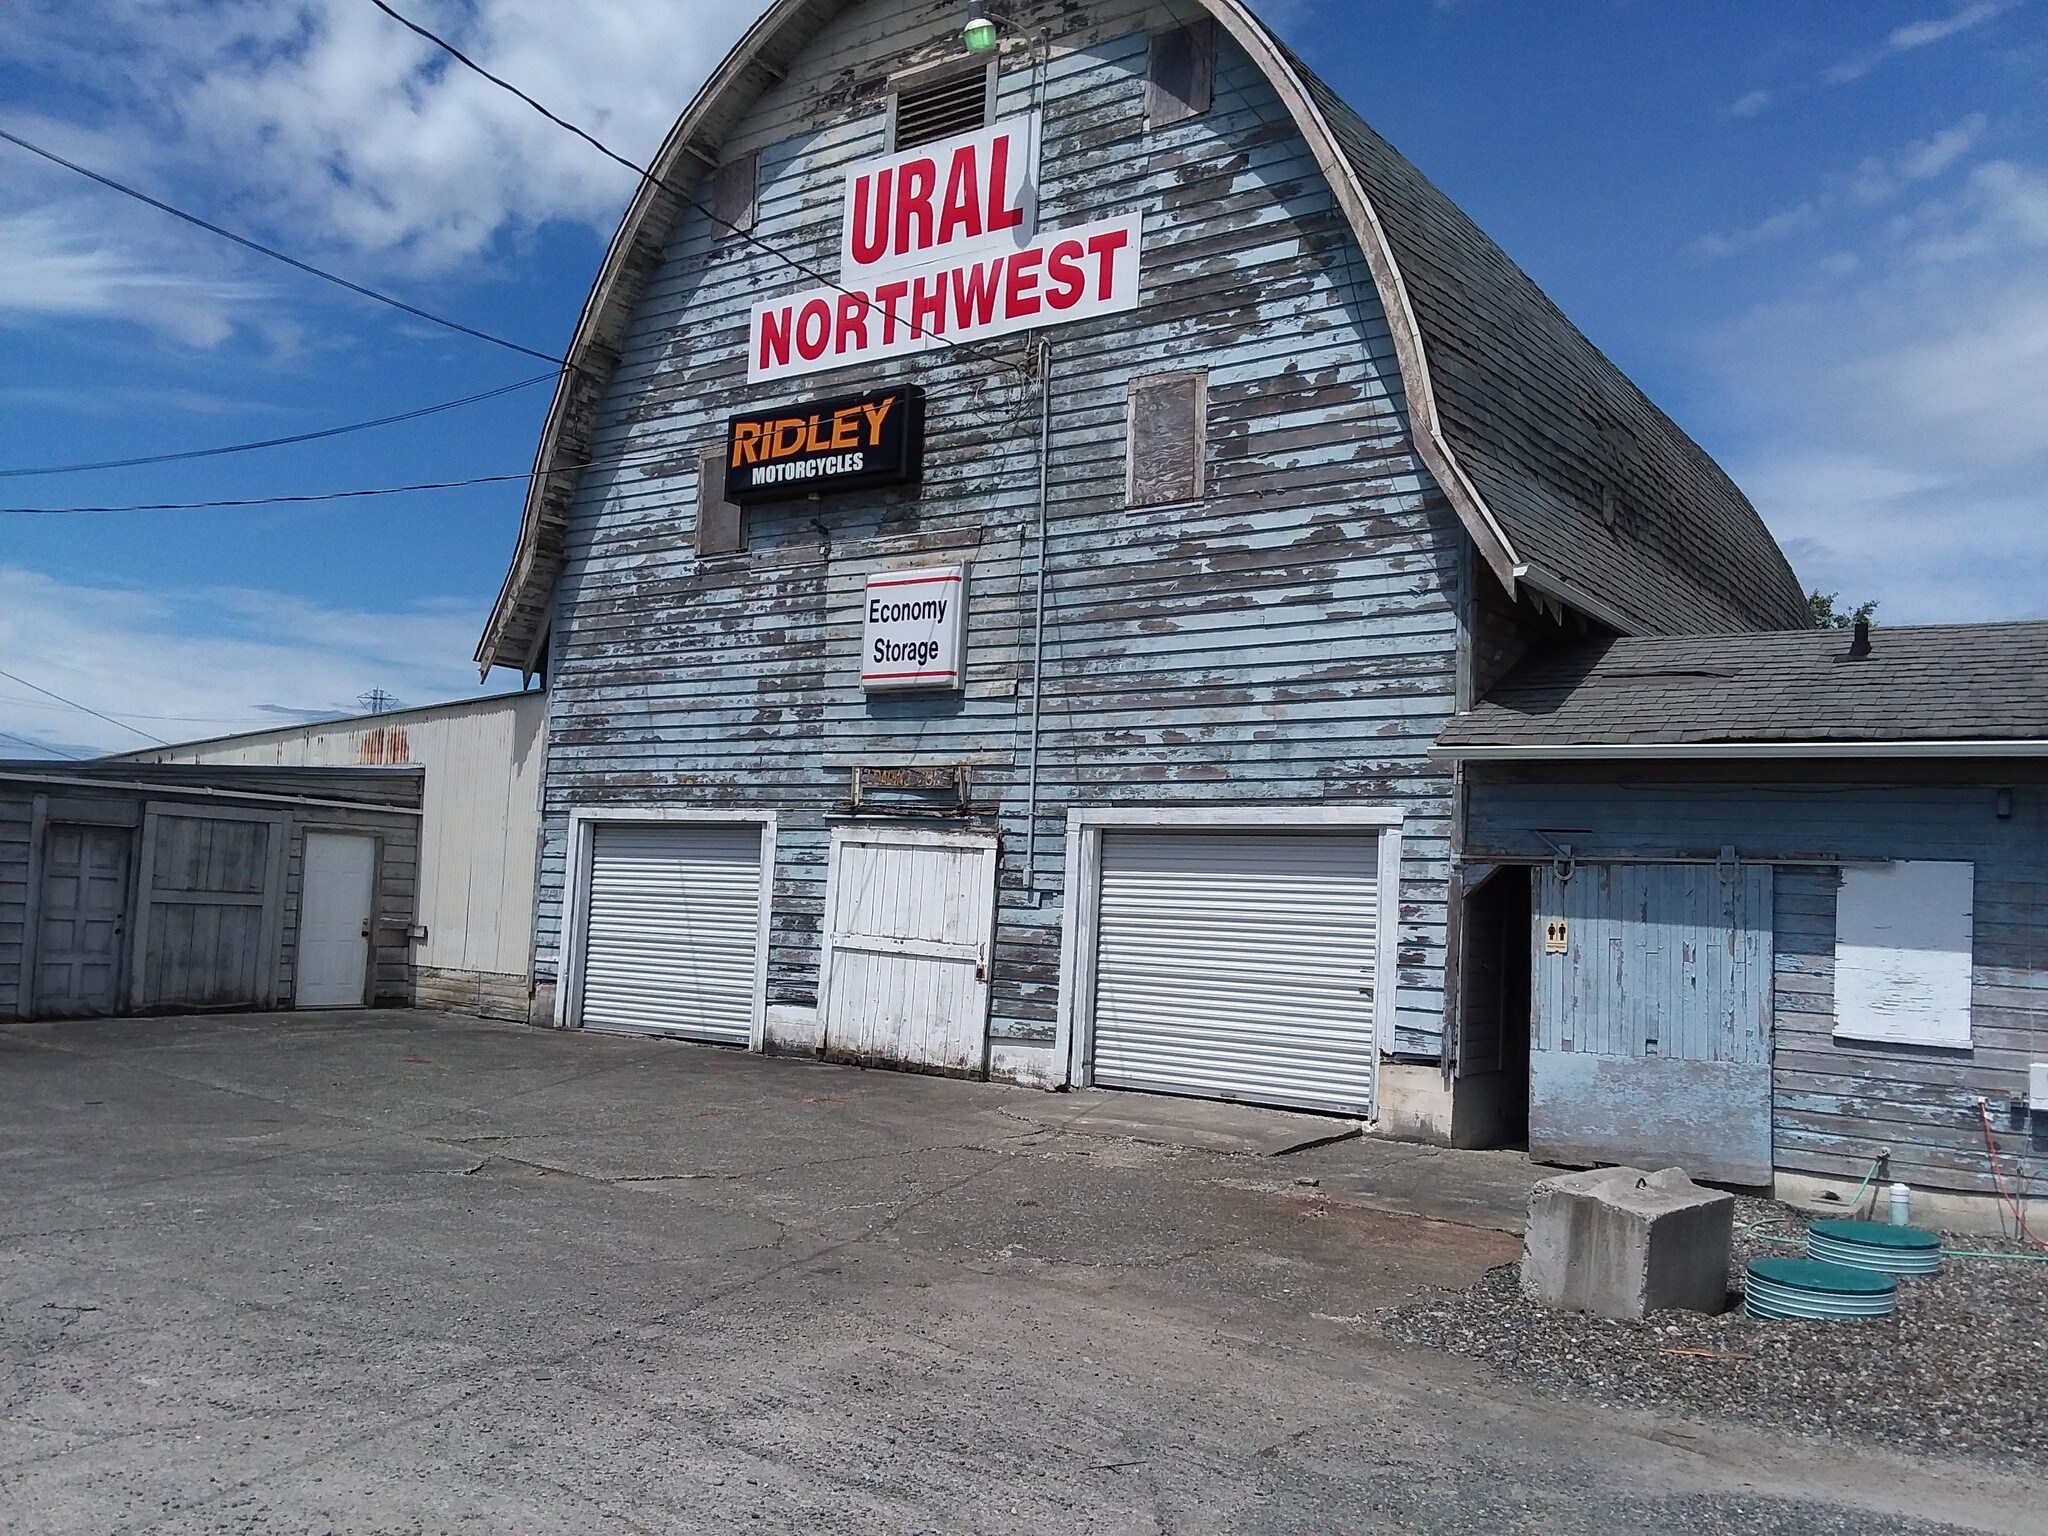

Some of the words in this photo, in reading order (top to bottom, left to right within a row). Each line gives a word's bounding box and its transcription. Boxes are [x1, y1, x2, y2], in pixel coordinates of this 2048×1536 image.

[850, 135, 1024, 265] URAL
[759, 229, 1128, 370] NORTHWEST
[732, 396, 896, 468] RIDLEY
[752, 452, 864, 485] MOTORCYCLES
[869, 598, 948, 624] Economy
[873, 637, 939, 666] Storage
